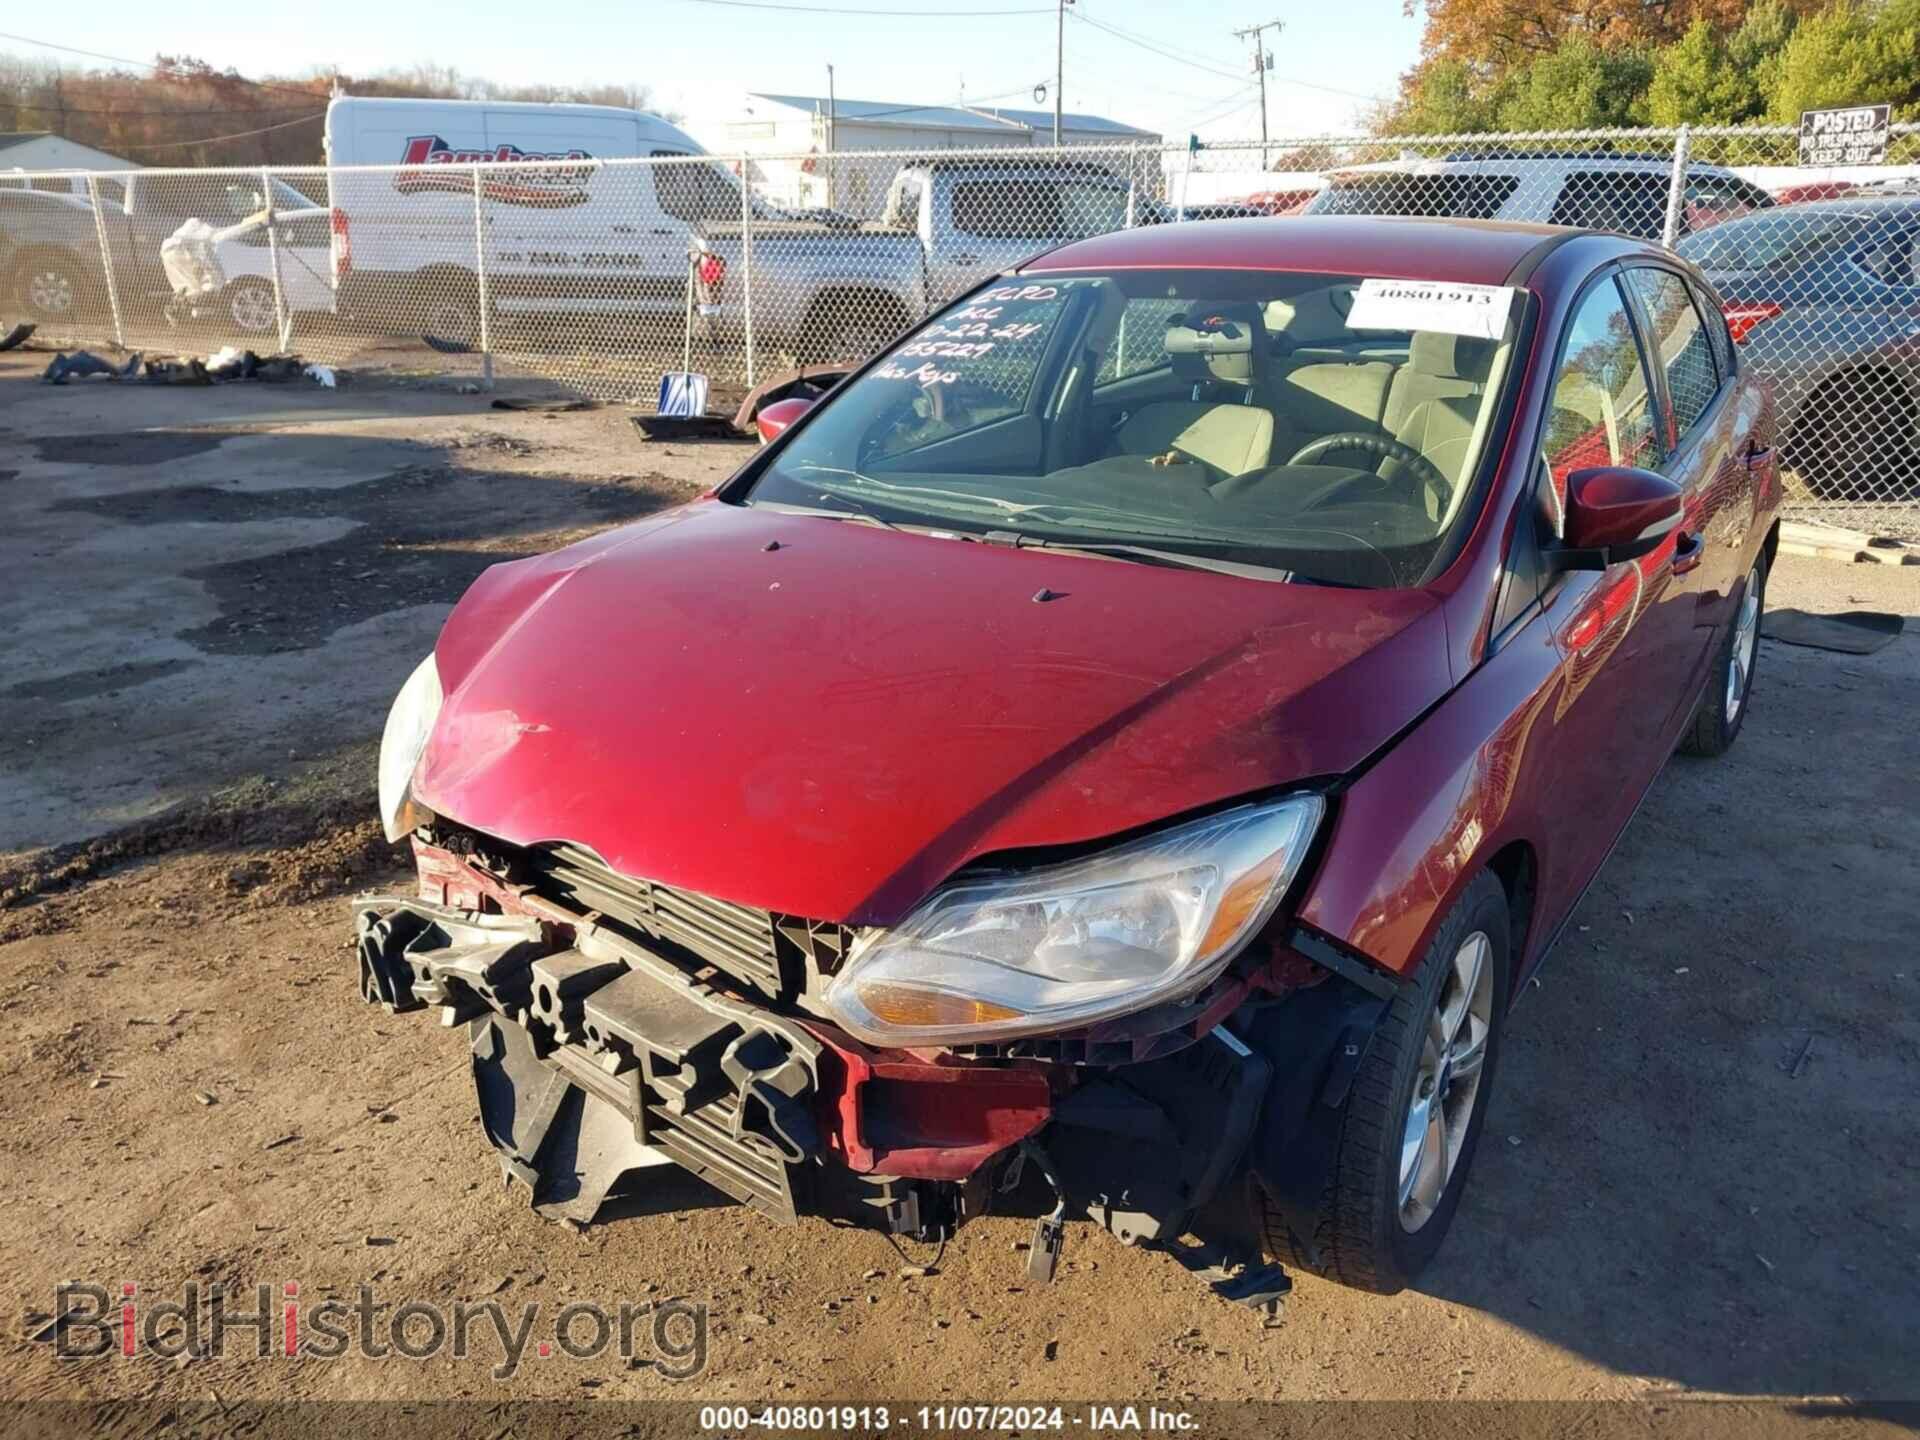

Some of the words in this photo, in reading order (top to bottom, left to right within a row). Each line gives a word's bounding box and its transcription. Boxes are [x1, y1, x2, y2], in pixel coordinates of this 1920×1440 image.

[1813, 109, 1875, 132] POSTED
[1800, 135, 1816, 150] NO
[1811, 150, 1843, 163] KEEP
[1845, 147, 1872, 162] OUT
[1374, 288, 1492, 305] 40801913
